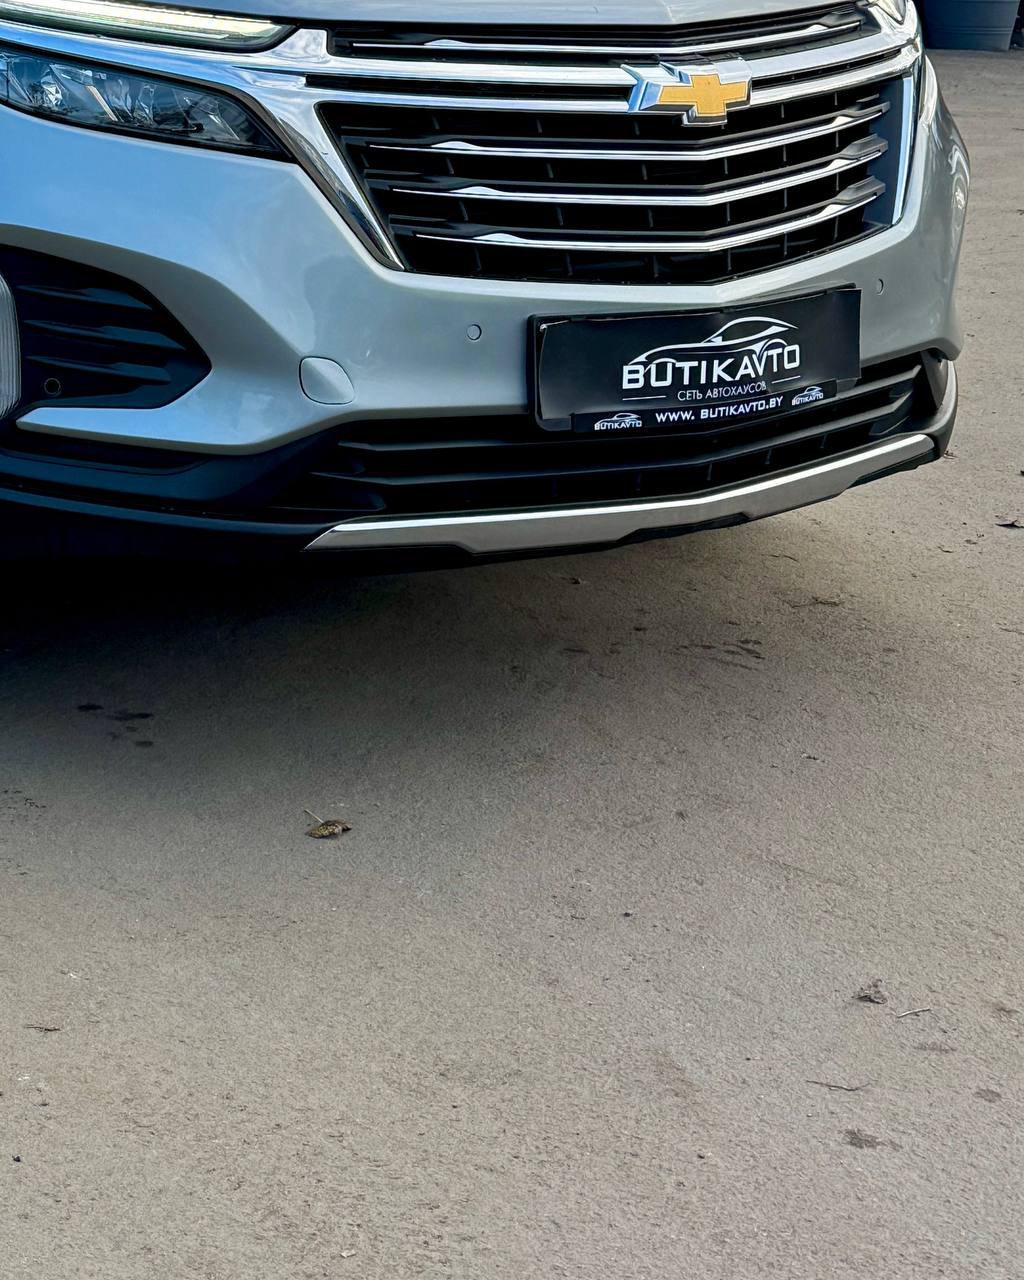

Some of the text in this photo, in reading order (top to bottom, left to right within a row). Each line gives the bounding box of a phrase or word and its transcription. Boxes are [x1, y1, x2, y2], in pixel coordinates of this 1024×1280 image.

[622, 344, 801, 390] BUTIKAVTO
[677, 380, 768, 402] СЕТЬ АВТОХАУСОВ
[791, 391, 824, 406] BUTIKAVTO
[655, 395, 784, 423] WWW. BUTIKAVTO.BY
[594, 420, 643, 431] BUTIKAVTO
